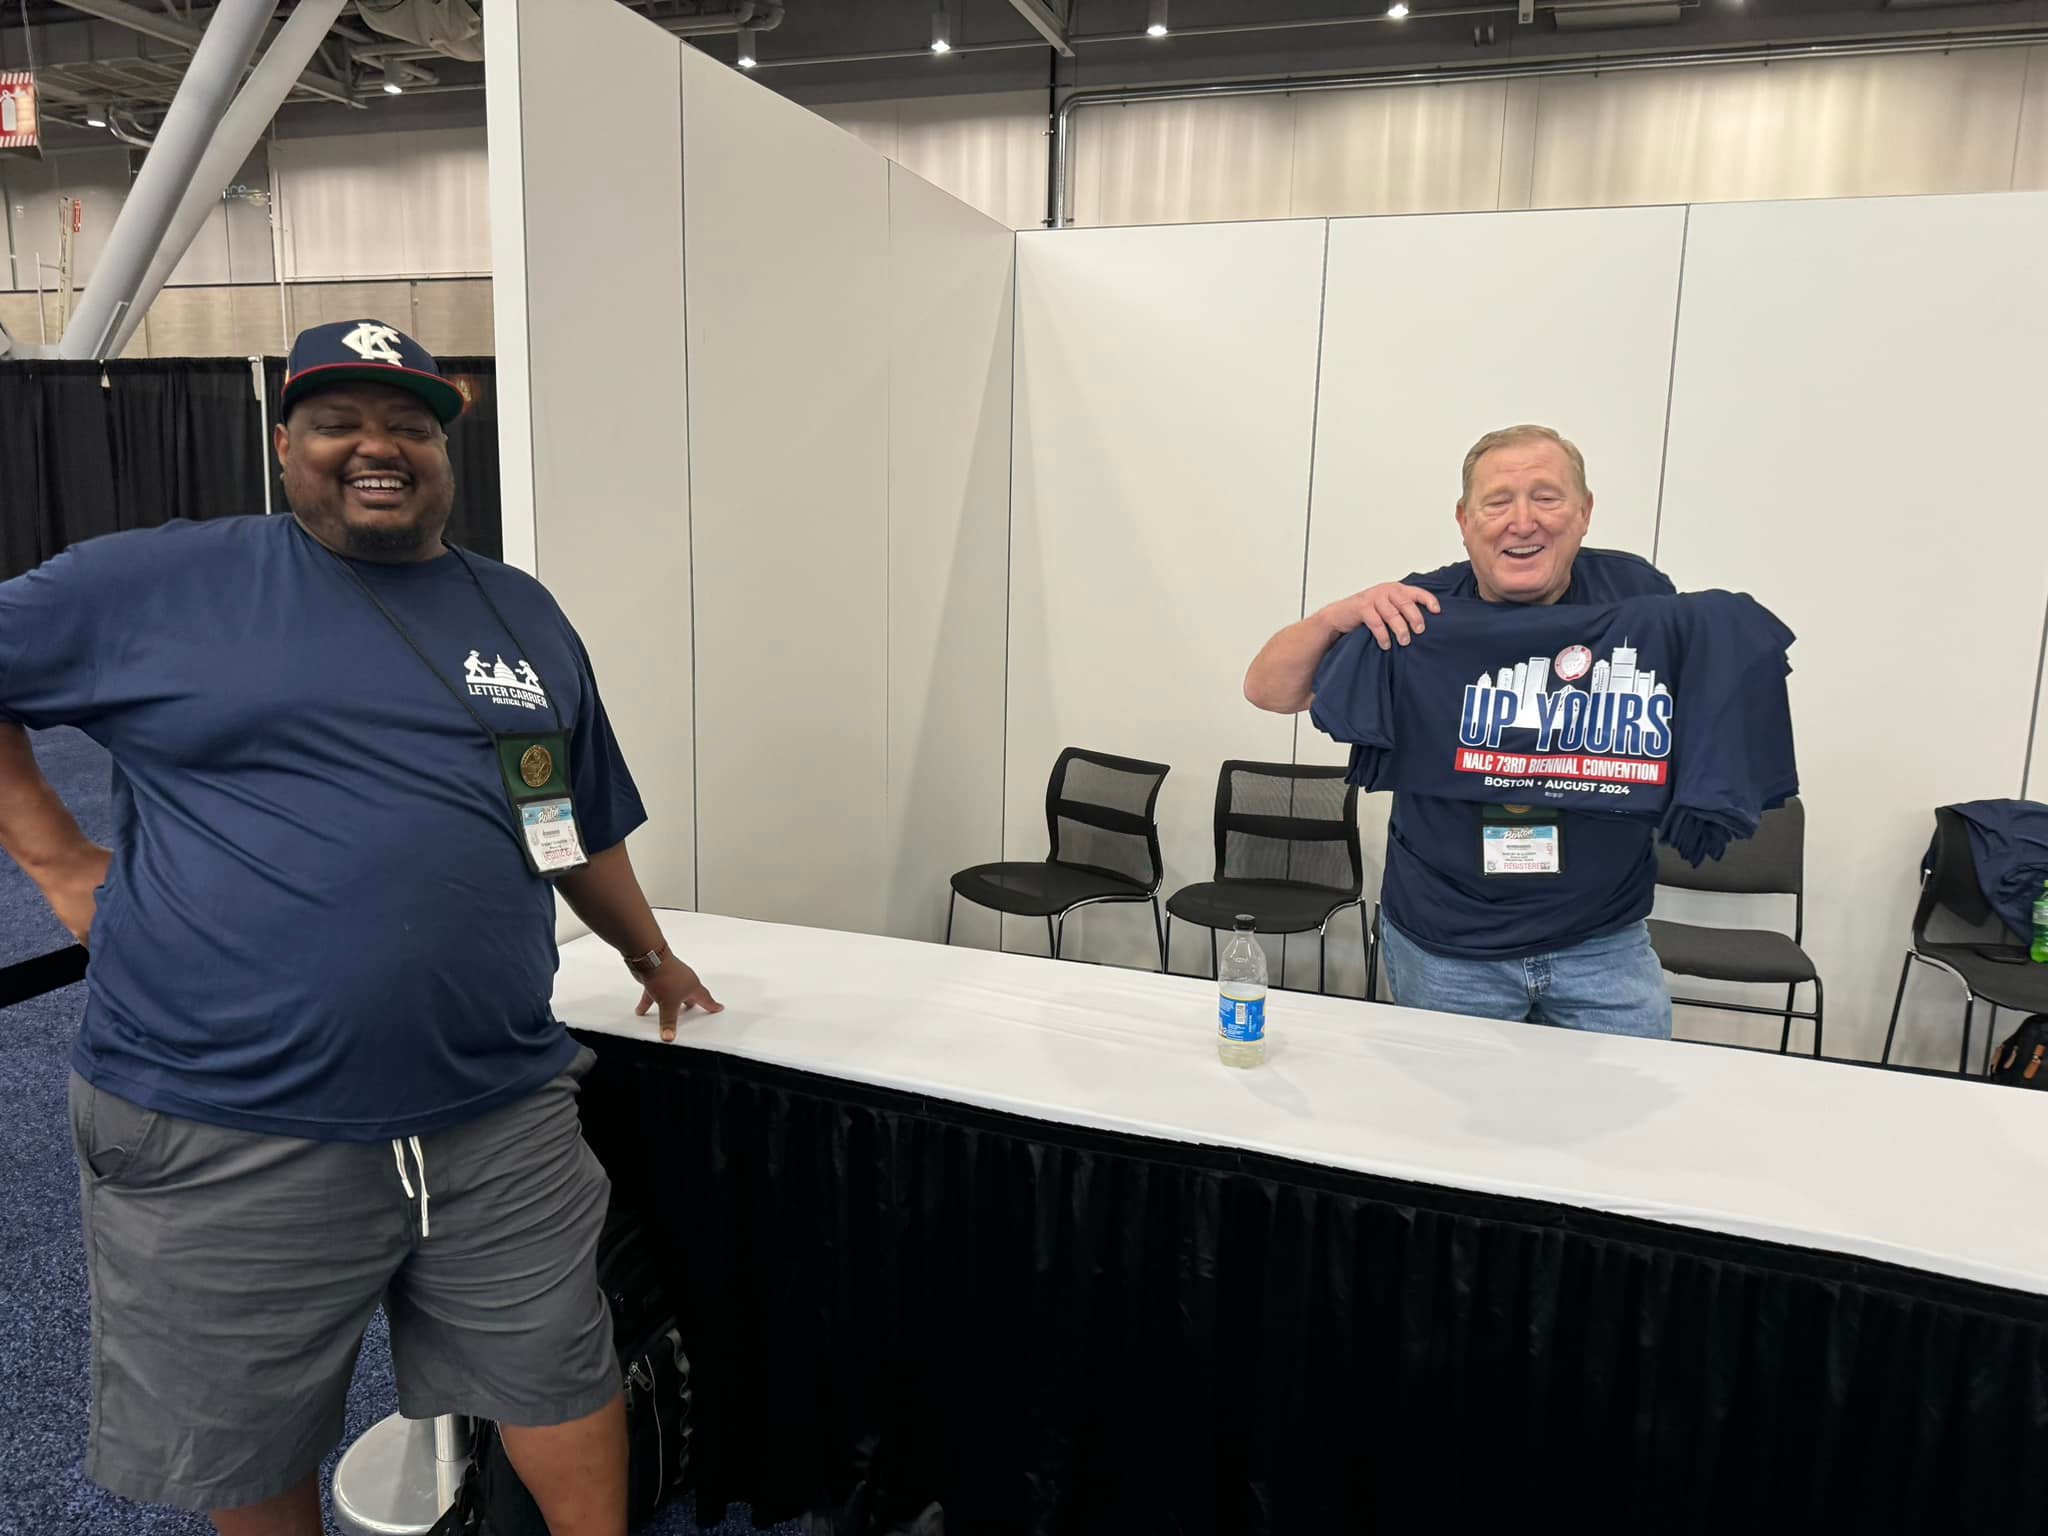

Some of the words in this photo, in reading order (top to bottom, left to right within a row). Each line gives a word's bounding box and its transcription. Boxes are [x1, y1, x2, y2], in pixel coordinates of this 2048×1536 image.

[467, 683, 508, 697] LETTER
[509, 686, 548, 709] CARRIER
[492, 696, 522, 707] POLITICAL
[1459, 684, 1518, 748] UP
[1535, 689, 1673, 758] YOURS
[1462, 752, 1493, 771] NALC
[1495, 755, 1526, 774] 73RD
[1528, 758, 1579, 775] BIENNIAL
[1582, 759, 1660, 781] CONVENTION
[1484, 776, 1534, 788] BOSTON
[1544, 780, 1597, 792] AUGUST
[1598, 784, 1631, 795] 2024
